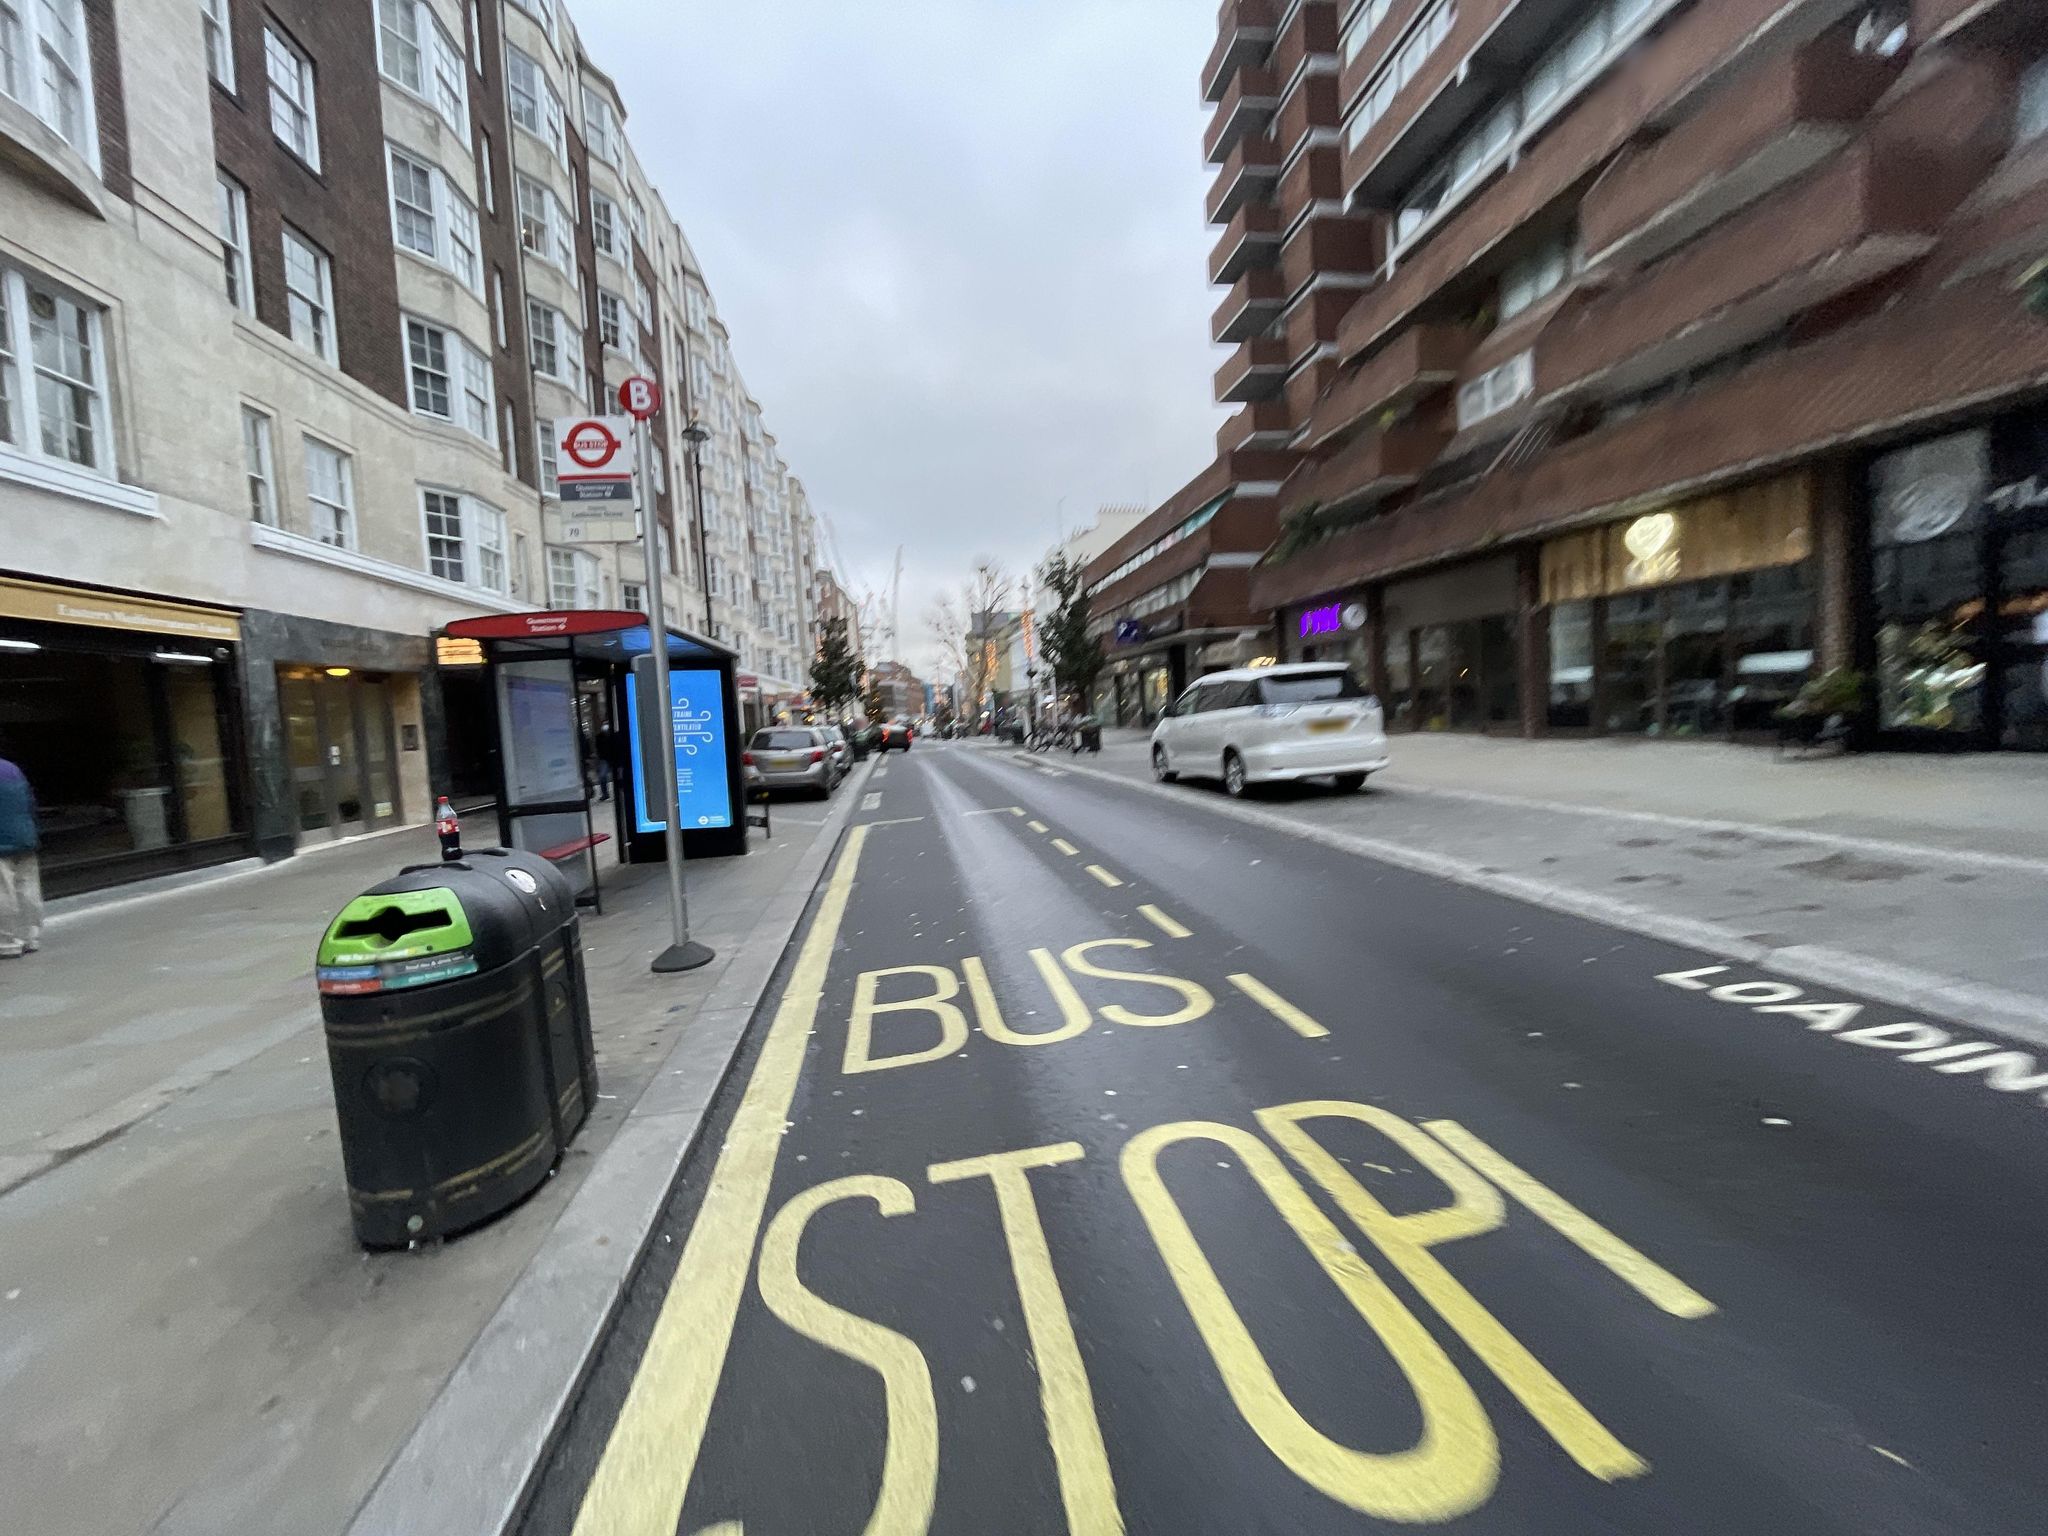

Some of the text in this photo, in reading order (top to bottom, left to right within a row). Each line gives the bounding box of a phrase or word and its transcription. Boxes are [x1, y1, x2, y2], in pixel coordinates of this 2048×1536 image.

[630, 381, 651, 410] B
[841, 938, 1215, 1075] BUS
[1652, 965, 2048, 1108] LOADIN
[689, 1101, 1653, 1536] STOP
